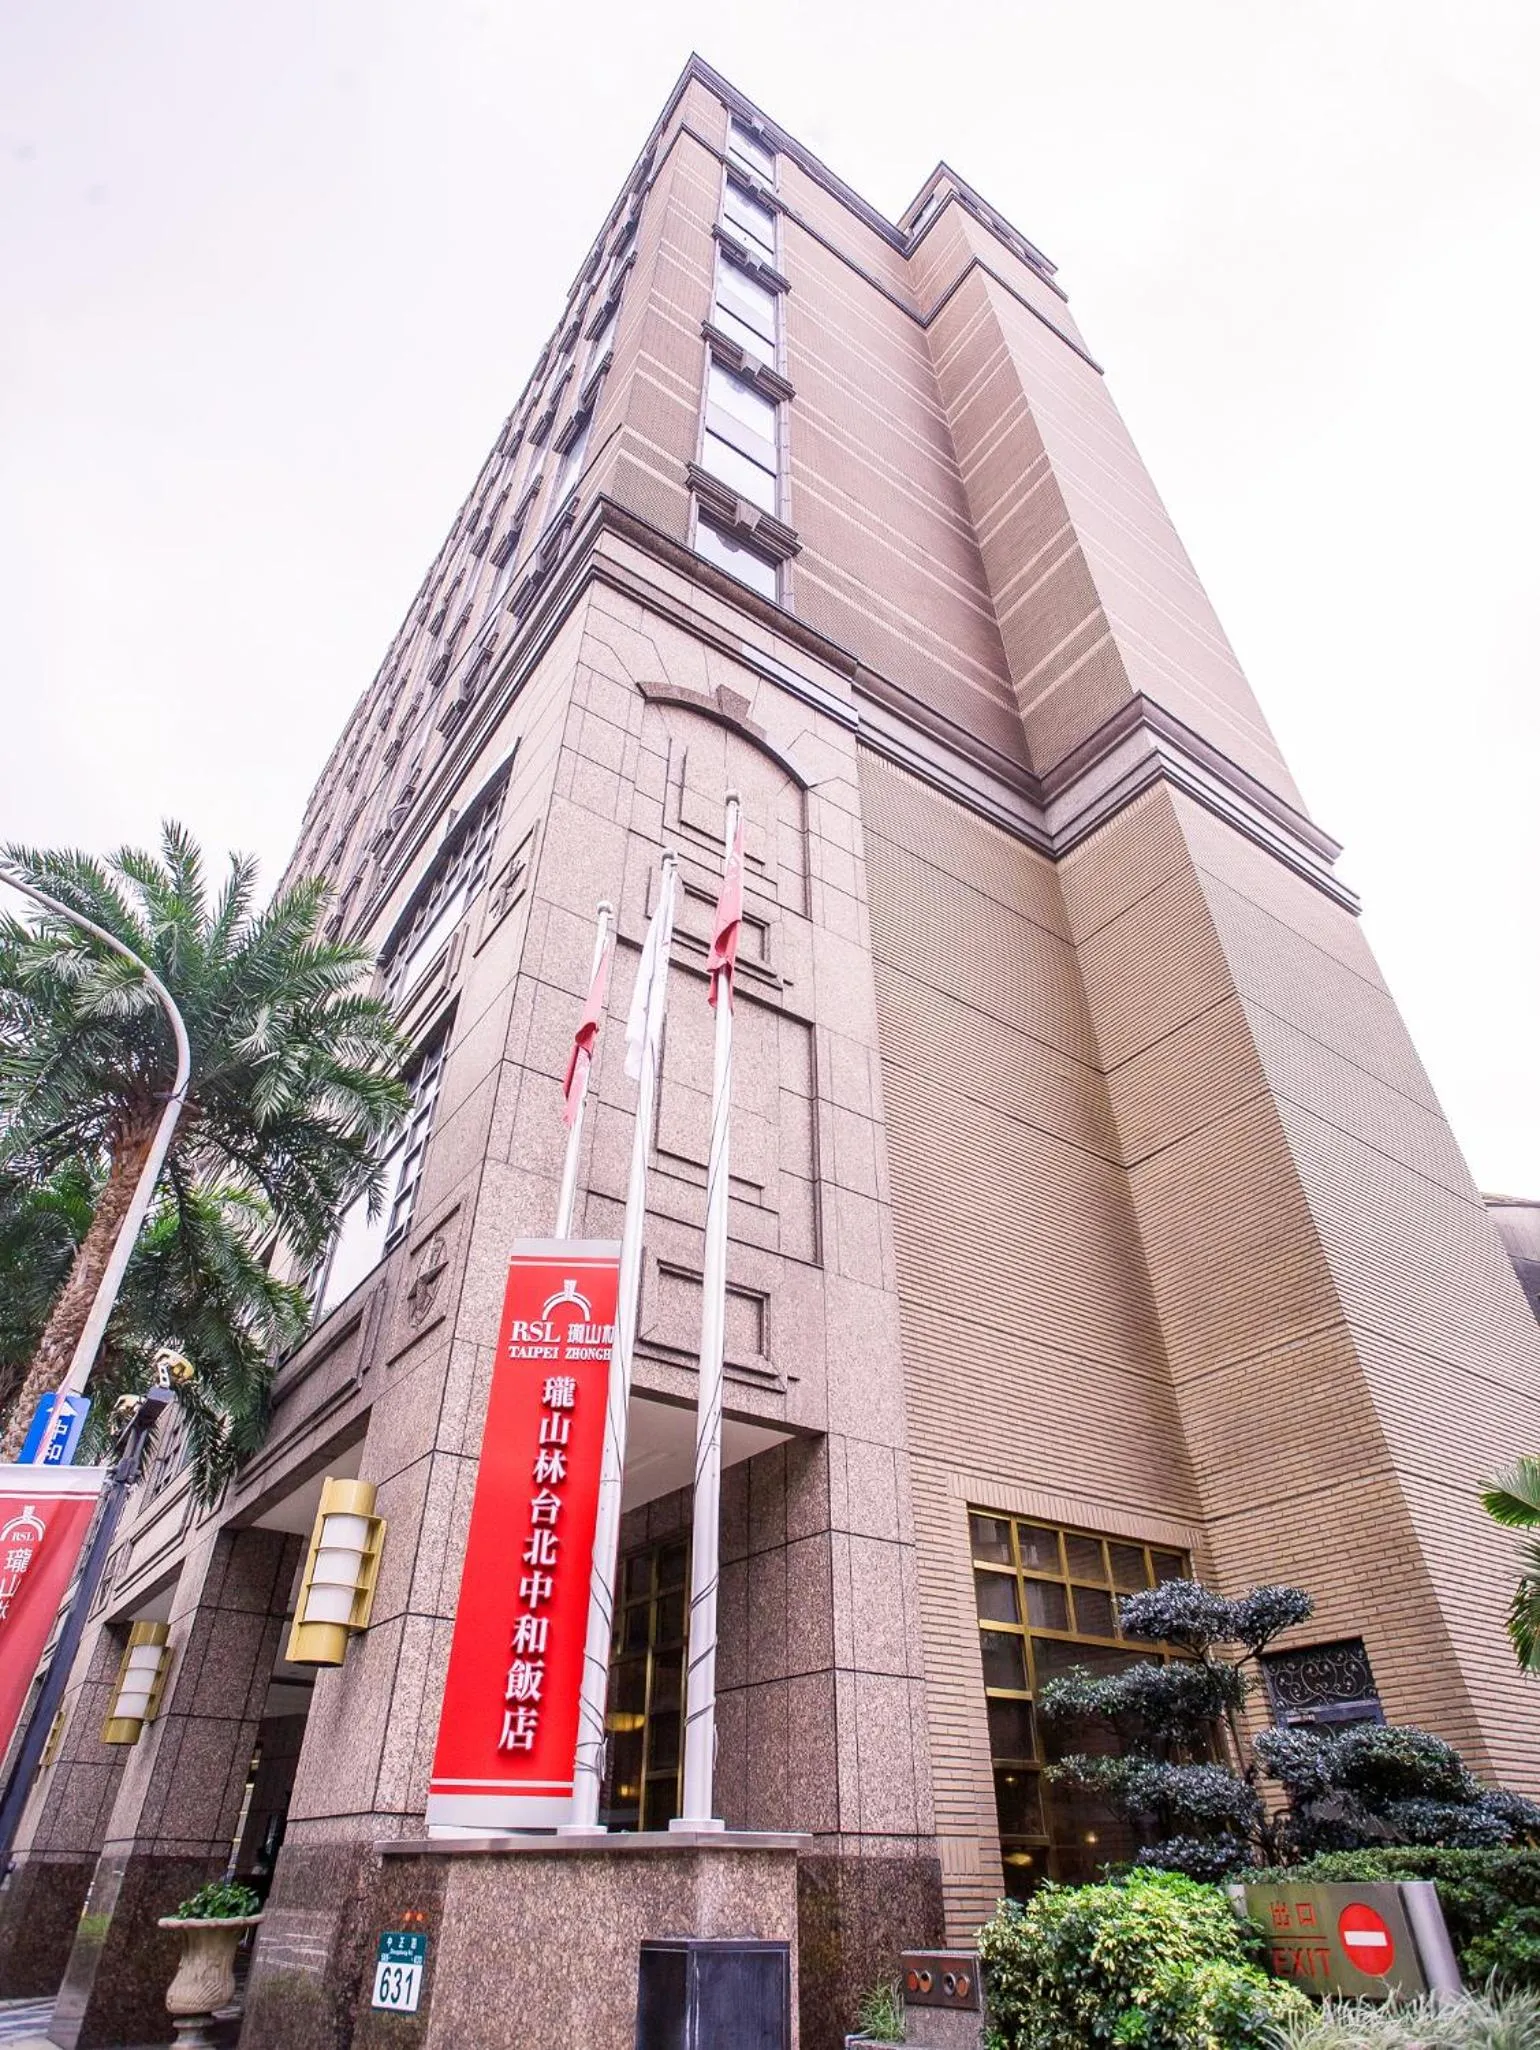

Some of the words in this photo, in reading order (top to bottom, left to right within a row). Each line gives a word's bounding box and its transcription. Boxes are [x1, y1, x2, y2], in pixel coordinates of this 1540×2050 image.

[510, 1320, 561, 1343] RSL
[508, 1346, 560, 1360] TAIPEI
[565, 1347, 612, 1361] ZHONGH
[12, 1531, 35, 1542] RSL
[498, 1375, 577, 1751] 瓏山林台北中和飯店
[1270, 1902, 1316, 1930] 出口
[1271, 1947, 1331, 1978] EXIT
[379, 1966, 414, 2005] 631
